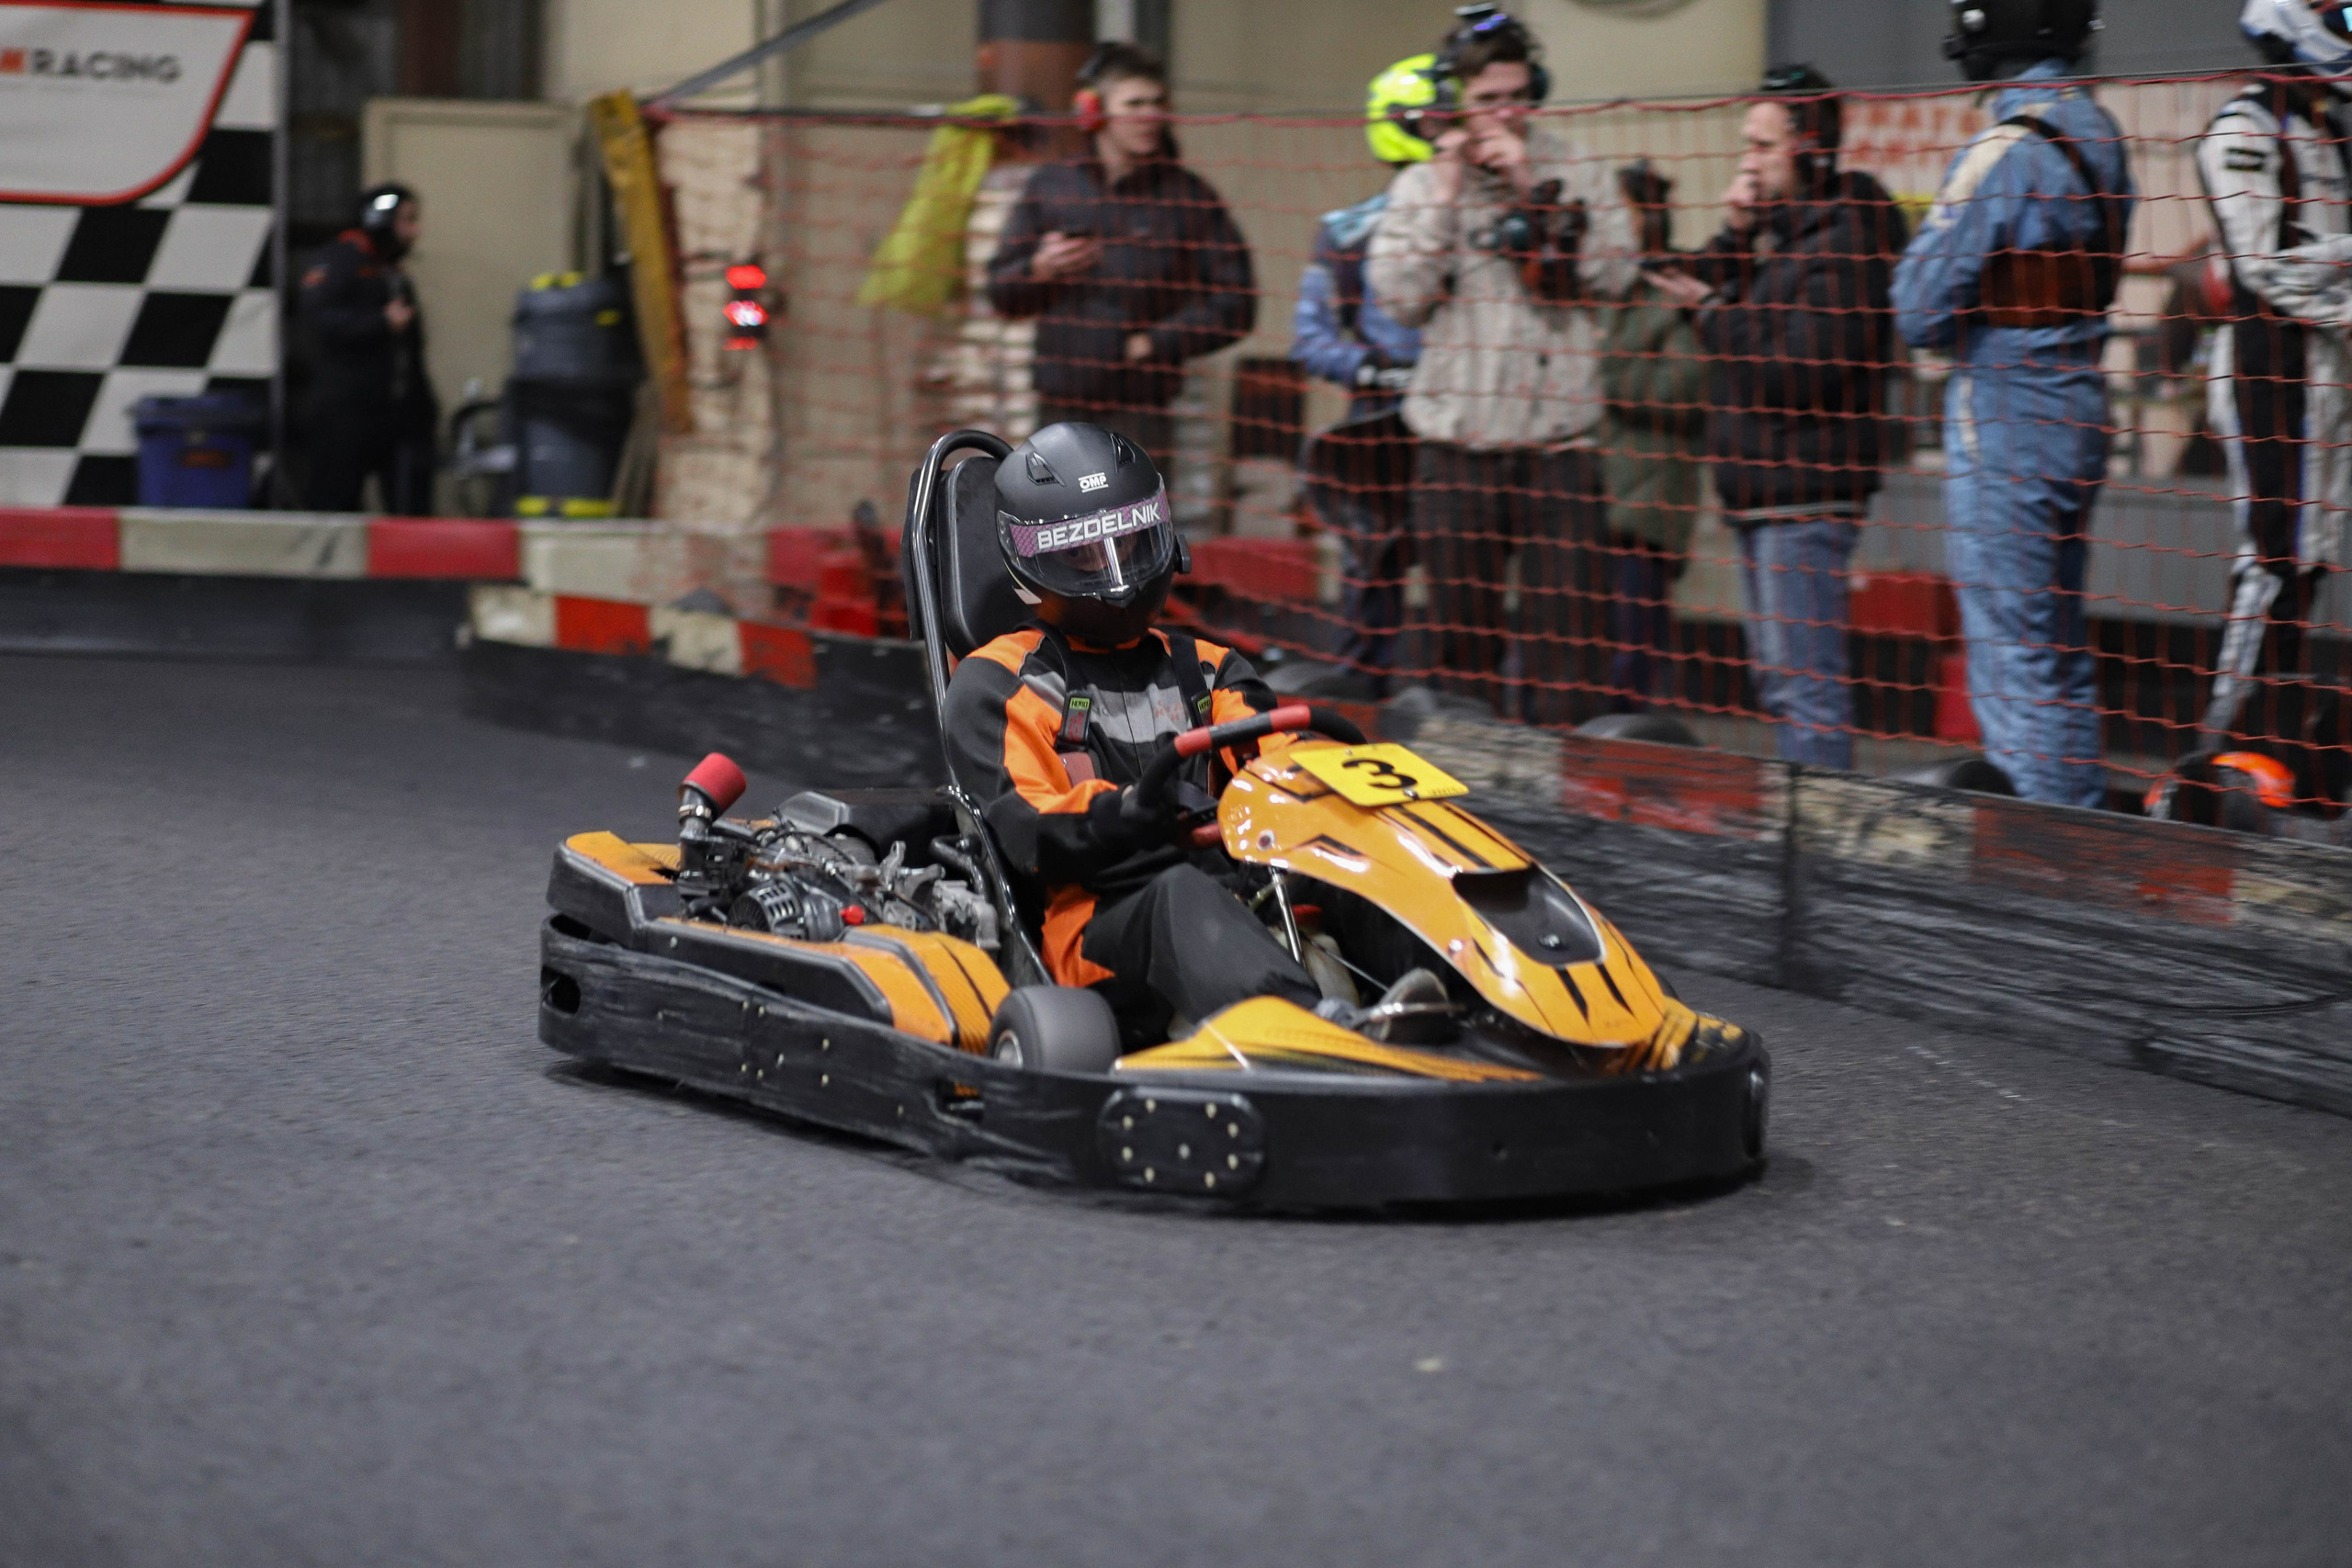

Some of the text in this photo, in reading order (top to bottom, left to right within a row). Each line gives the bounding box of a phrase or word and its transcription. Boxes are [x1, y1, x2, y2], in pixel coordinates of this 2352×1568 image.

[1080, 475, 1107, 490] OMP
[1037, 502, 1161, 549] BEZDELNIK
[1341, 759, 1419, 790] 3
